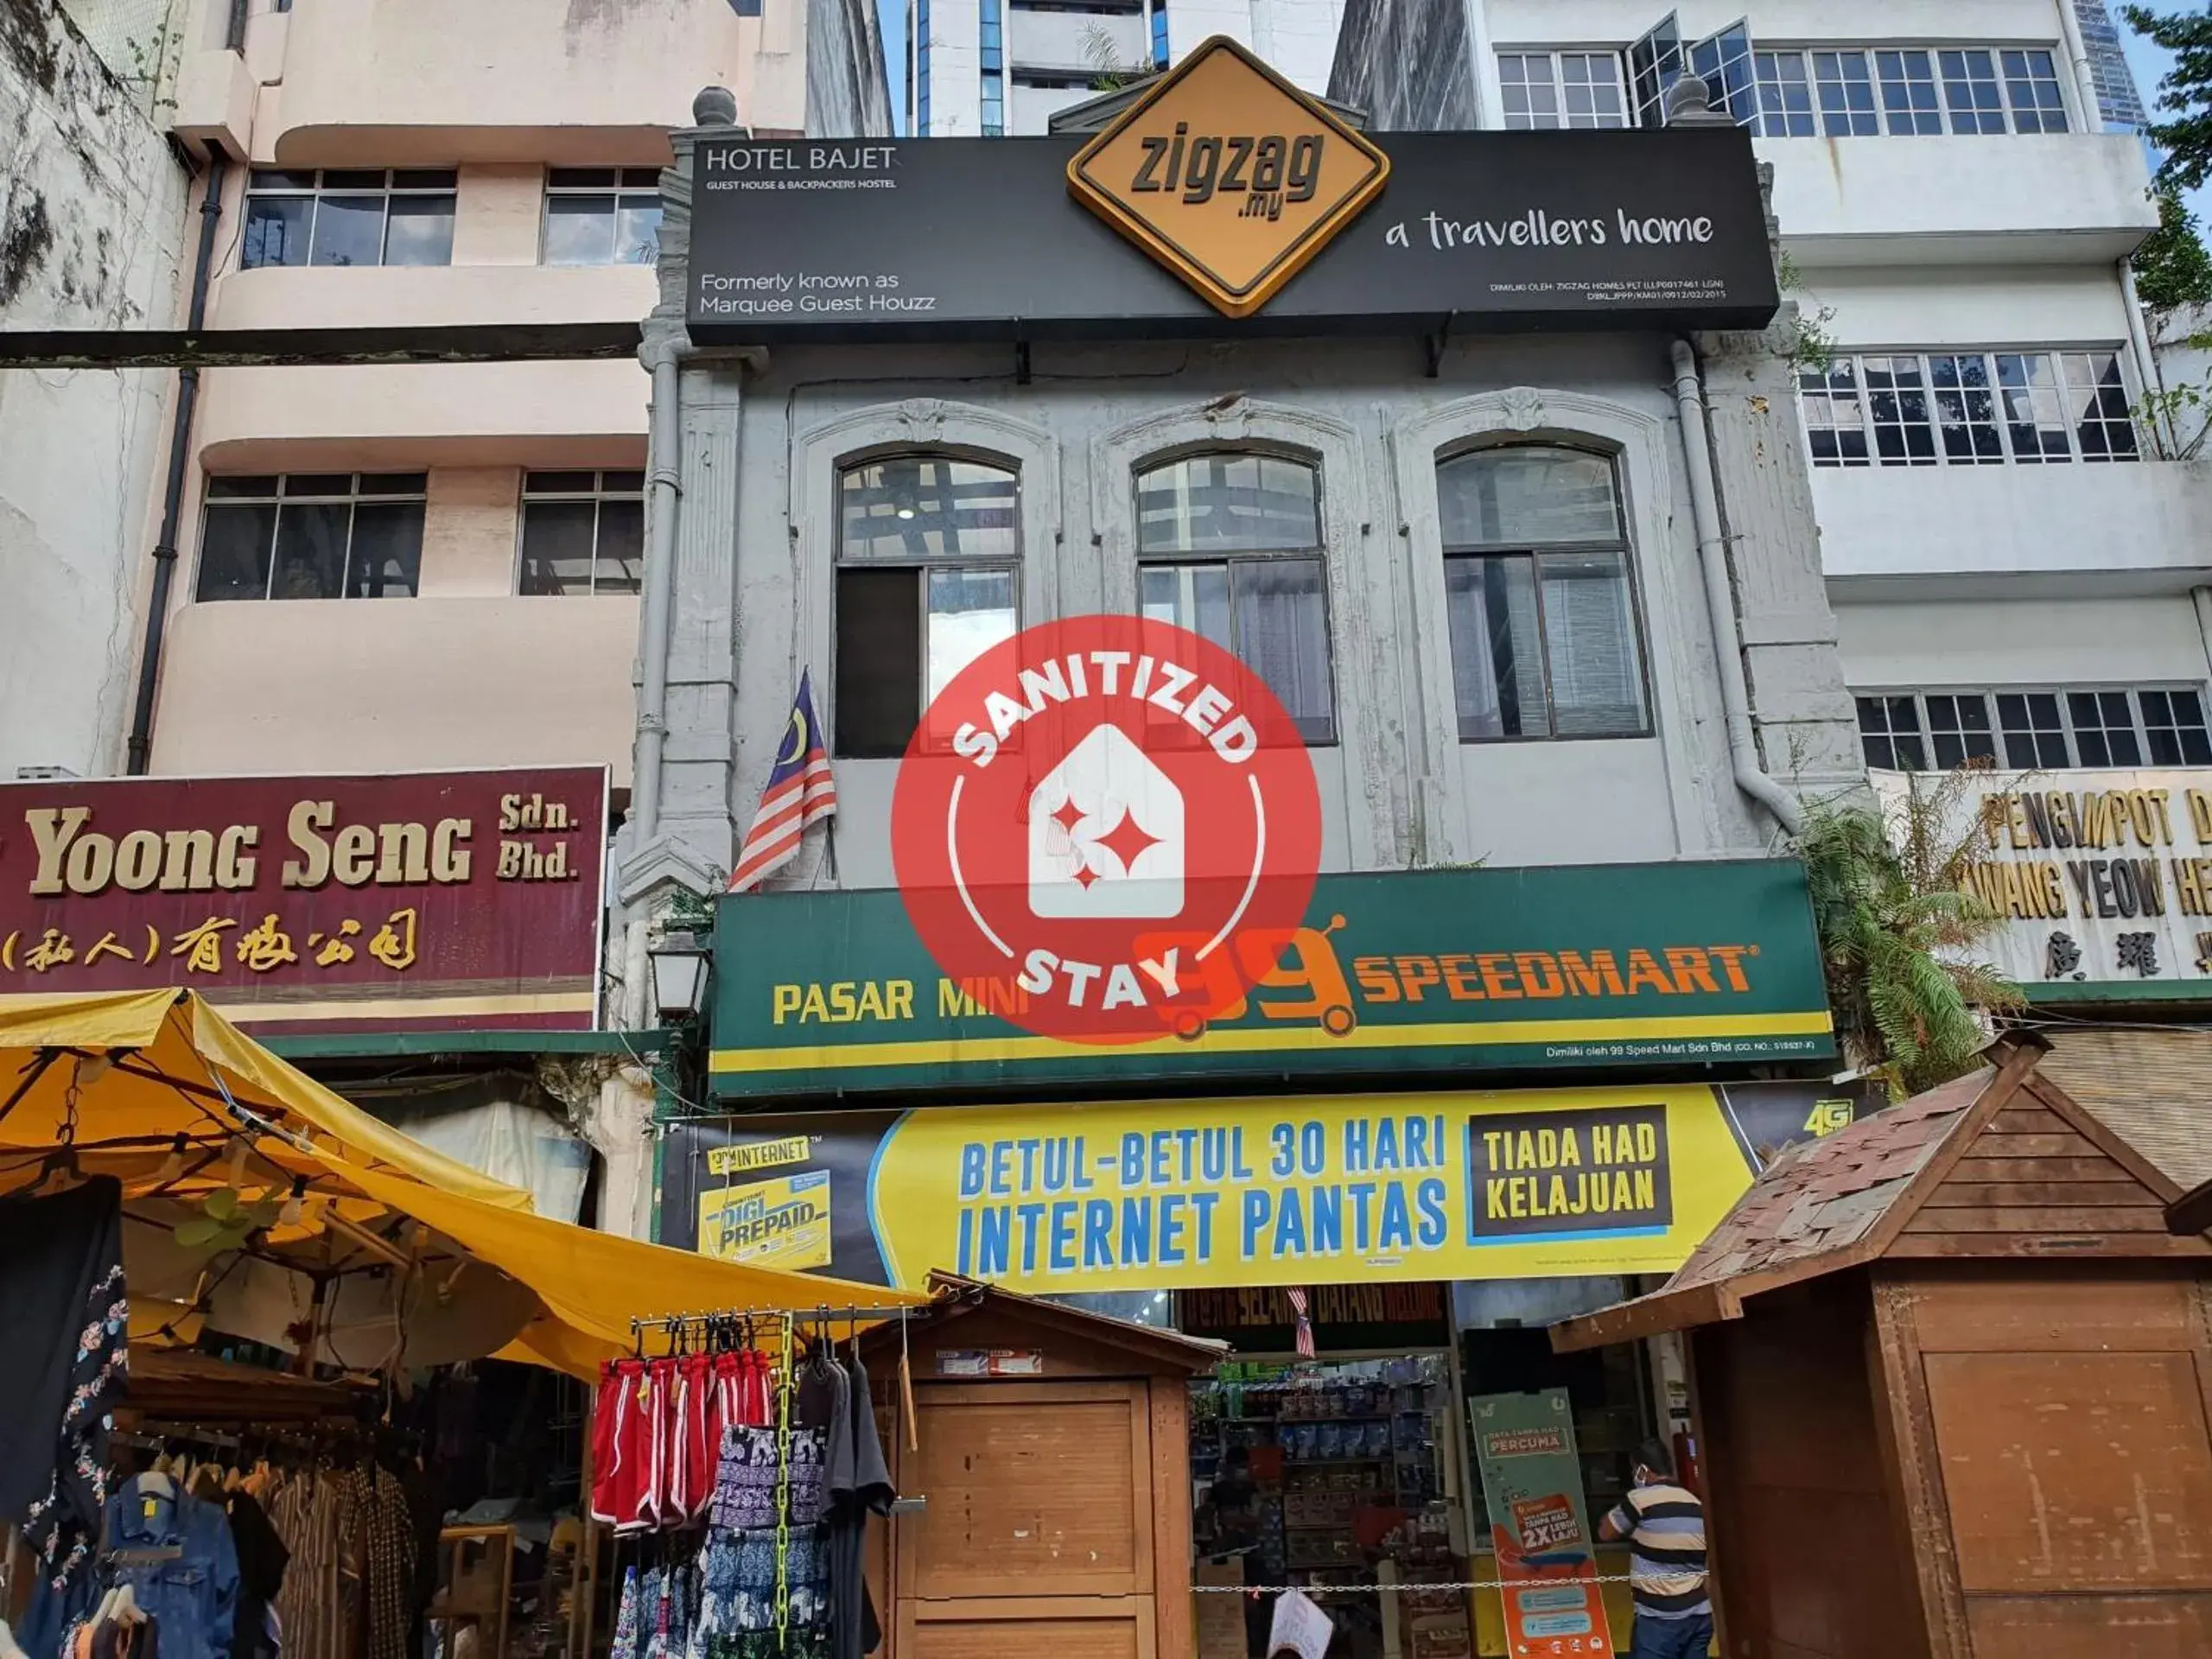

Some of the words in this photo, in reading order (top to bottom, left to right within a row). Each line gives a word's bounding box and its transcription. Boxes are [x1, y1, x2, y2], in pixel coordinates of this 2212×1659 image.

[707, 149, 800, 170] HOTEL
[810, 147, 897, 169] BAJET
[1130, 122, 1325, 204] zigzag
[707, 181, 740, 190] GUEST
[741, 180, 775, 189] HOUSE
[779, 180, 785, 189] &
[787, 179, 855, 189] BACKPACKERS
[858, 179, 897, 188] HOSTEL
[1385, 221, 1410, 248] a
[1421, 209, 1606, 249] travellers
[1618, 208, 1714, 244] home
[701, 273, 794, 294] Formerly
[799, 272, 869, 289] known
[874, 275, 899, 289] as
[1556, 282, 1591, 290] ZIGZAG
[1592, 282, 1625, 290] HOMES
[701, 296, 793, 315] Marquee
[800, 296, 862, 312] Guest
[869, 295, 936, 310] Houzz
[499, 793, 579, 831] Sdn.
[496, 841, 579, 880] Bhd.
[2068, 857, 2165, 920] YEOW
[773, 979, 915, 1025] PASAR
[938, 976, 1030, 1018] MINI
[1353, 944, 1749, 1003] SPEEDMART
[1546, 1046, 1583, 1058] Dimiliki
[1586, 1046, 1608, 1056] oleh
[1611, 1046, 1624, 1055] 99
[1625, 1044, 1660, 1056] Speed
[1662, 1043, 1686, 1054] Mart
[1688, 1042, 1708, 1053] Sdn
[1711, 1041, 1731, 1052] Bhd
[959, 1125, 1254, 1198] BETUL-BETUL
[1270, 1121, 1324, 1177] 30
[1344, 1114, 1446, 1172] HARI
[1483, 1125, 1580, 1173] TIADA
[1592, 1122, 1657, 1166] HAD
[722, 1197, 766, 1229] DIGI
[1486, 1169, 1655, 1220] KELAJUAN
[719, 1202, 815, 1253] PREPAID
[957, 1192, 1220, 1275] INTERNET
[1242, 1178, 1447, 1256] PANTAS
[1491, 1435, 1560, 1452] PERCUMA
[1522, 1525, 1553, 1549] 2X
